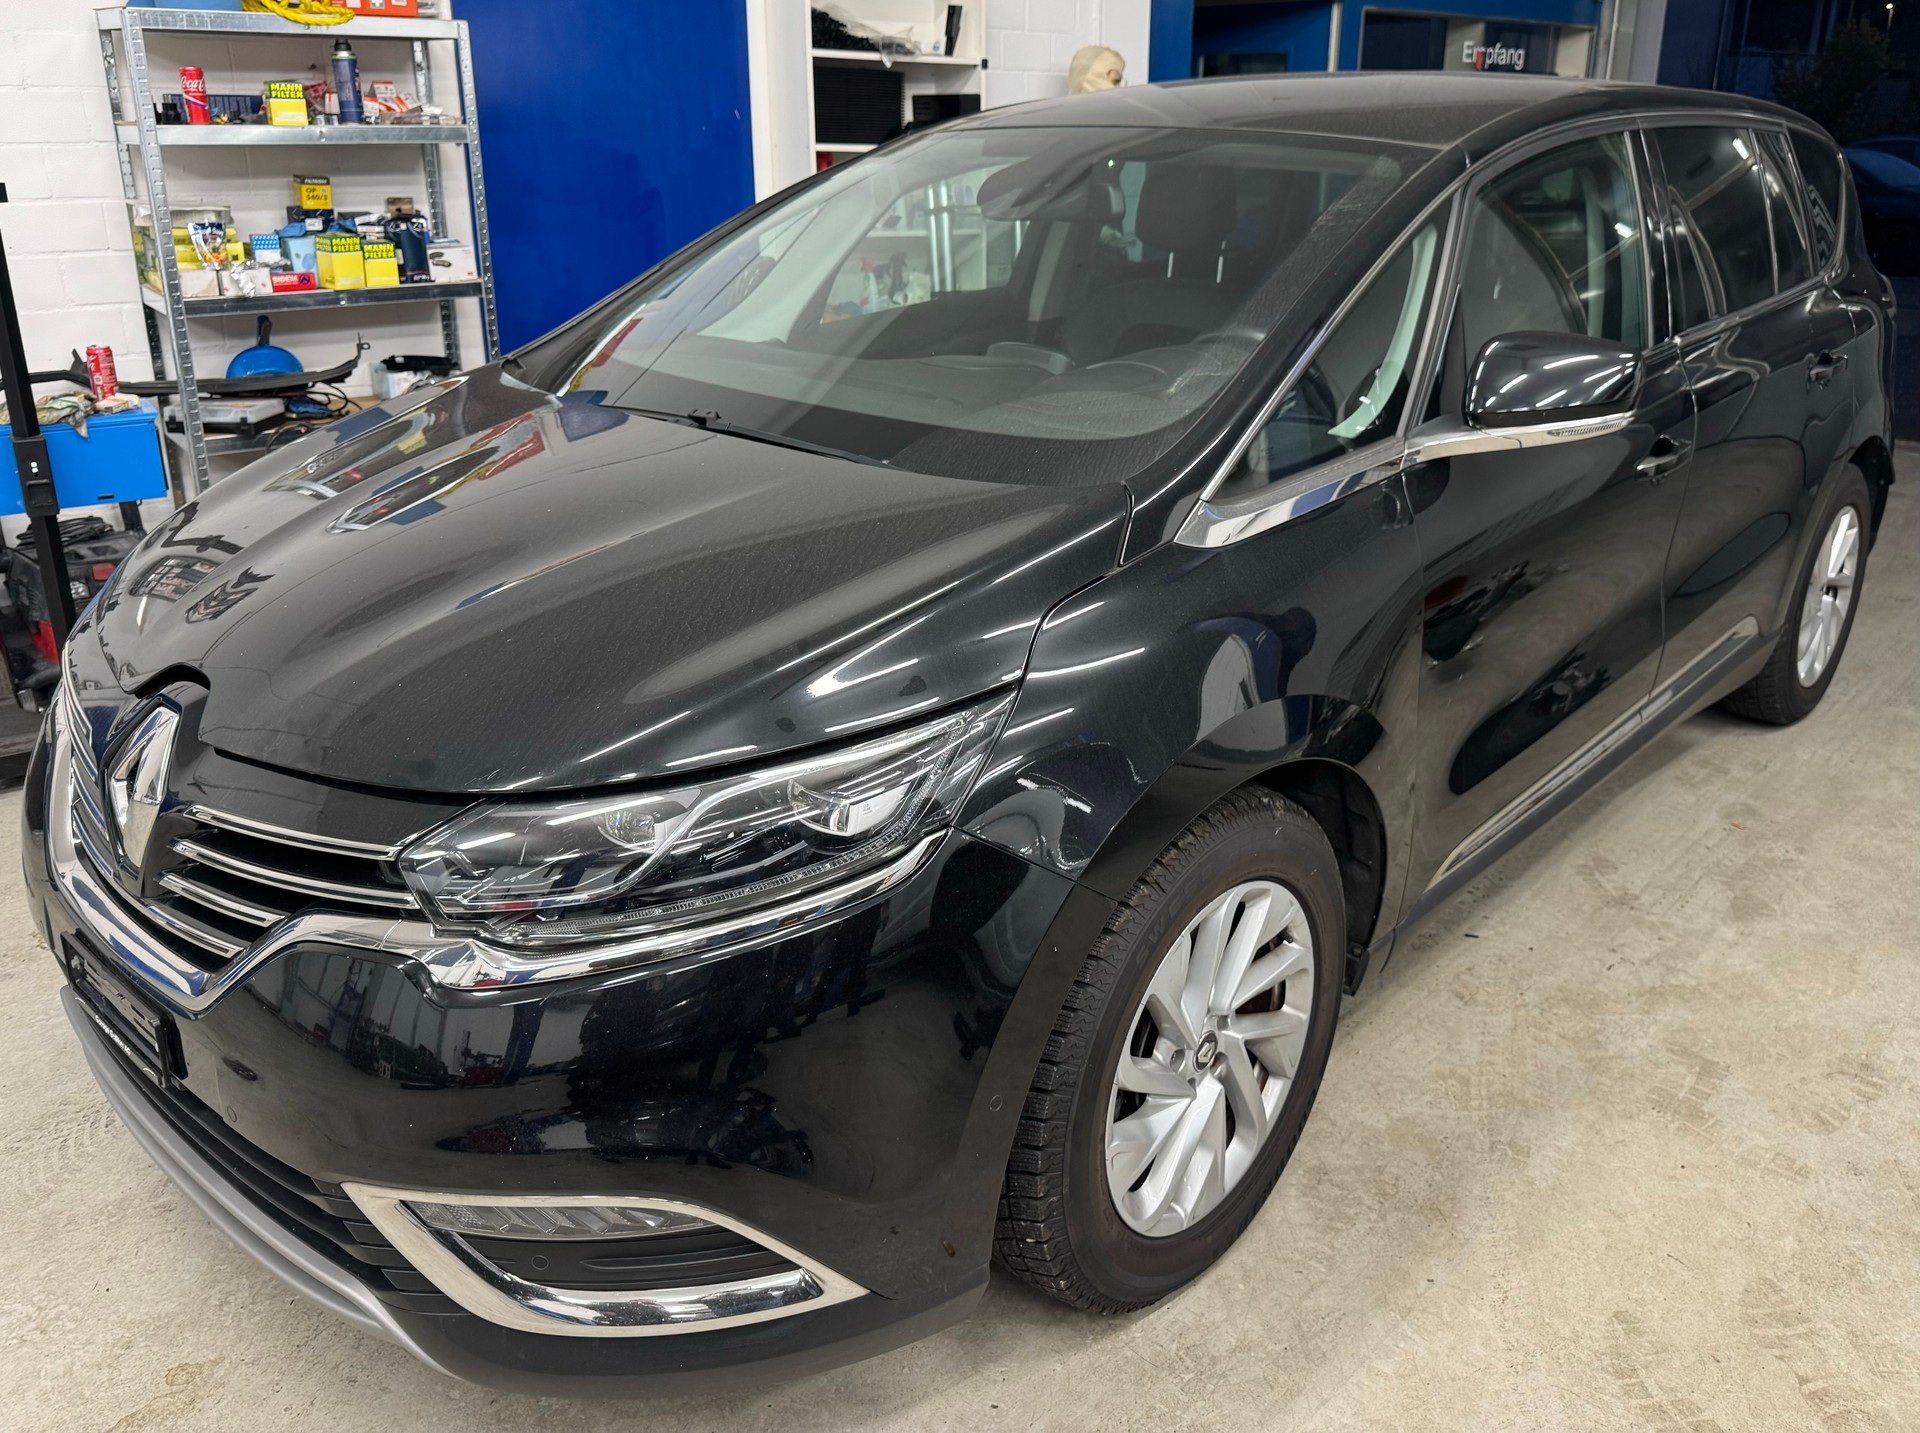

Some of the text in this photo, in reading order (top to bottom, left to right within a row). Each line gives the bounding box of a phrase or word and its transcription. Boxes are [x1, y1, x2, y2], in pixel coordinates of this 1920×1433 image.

[271, 83, 303, 91] MANN
[332, 237, 361, 245] MANN
[363, 244, 394, 252] MANN
